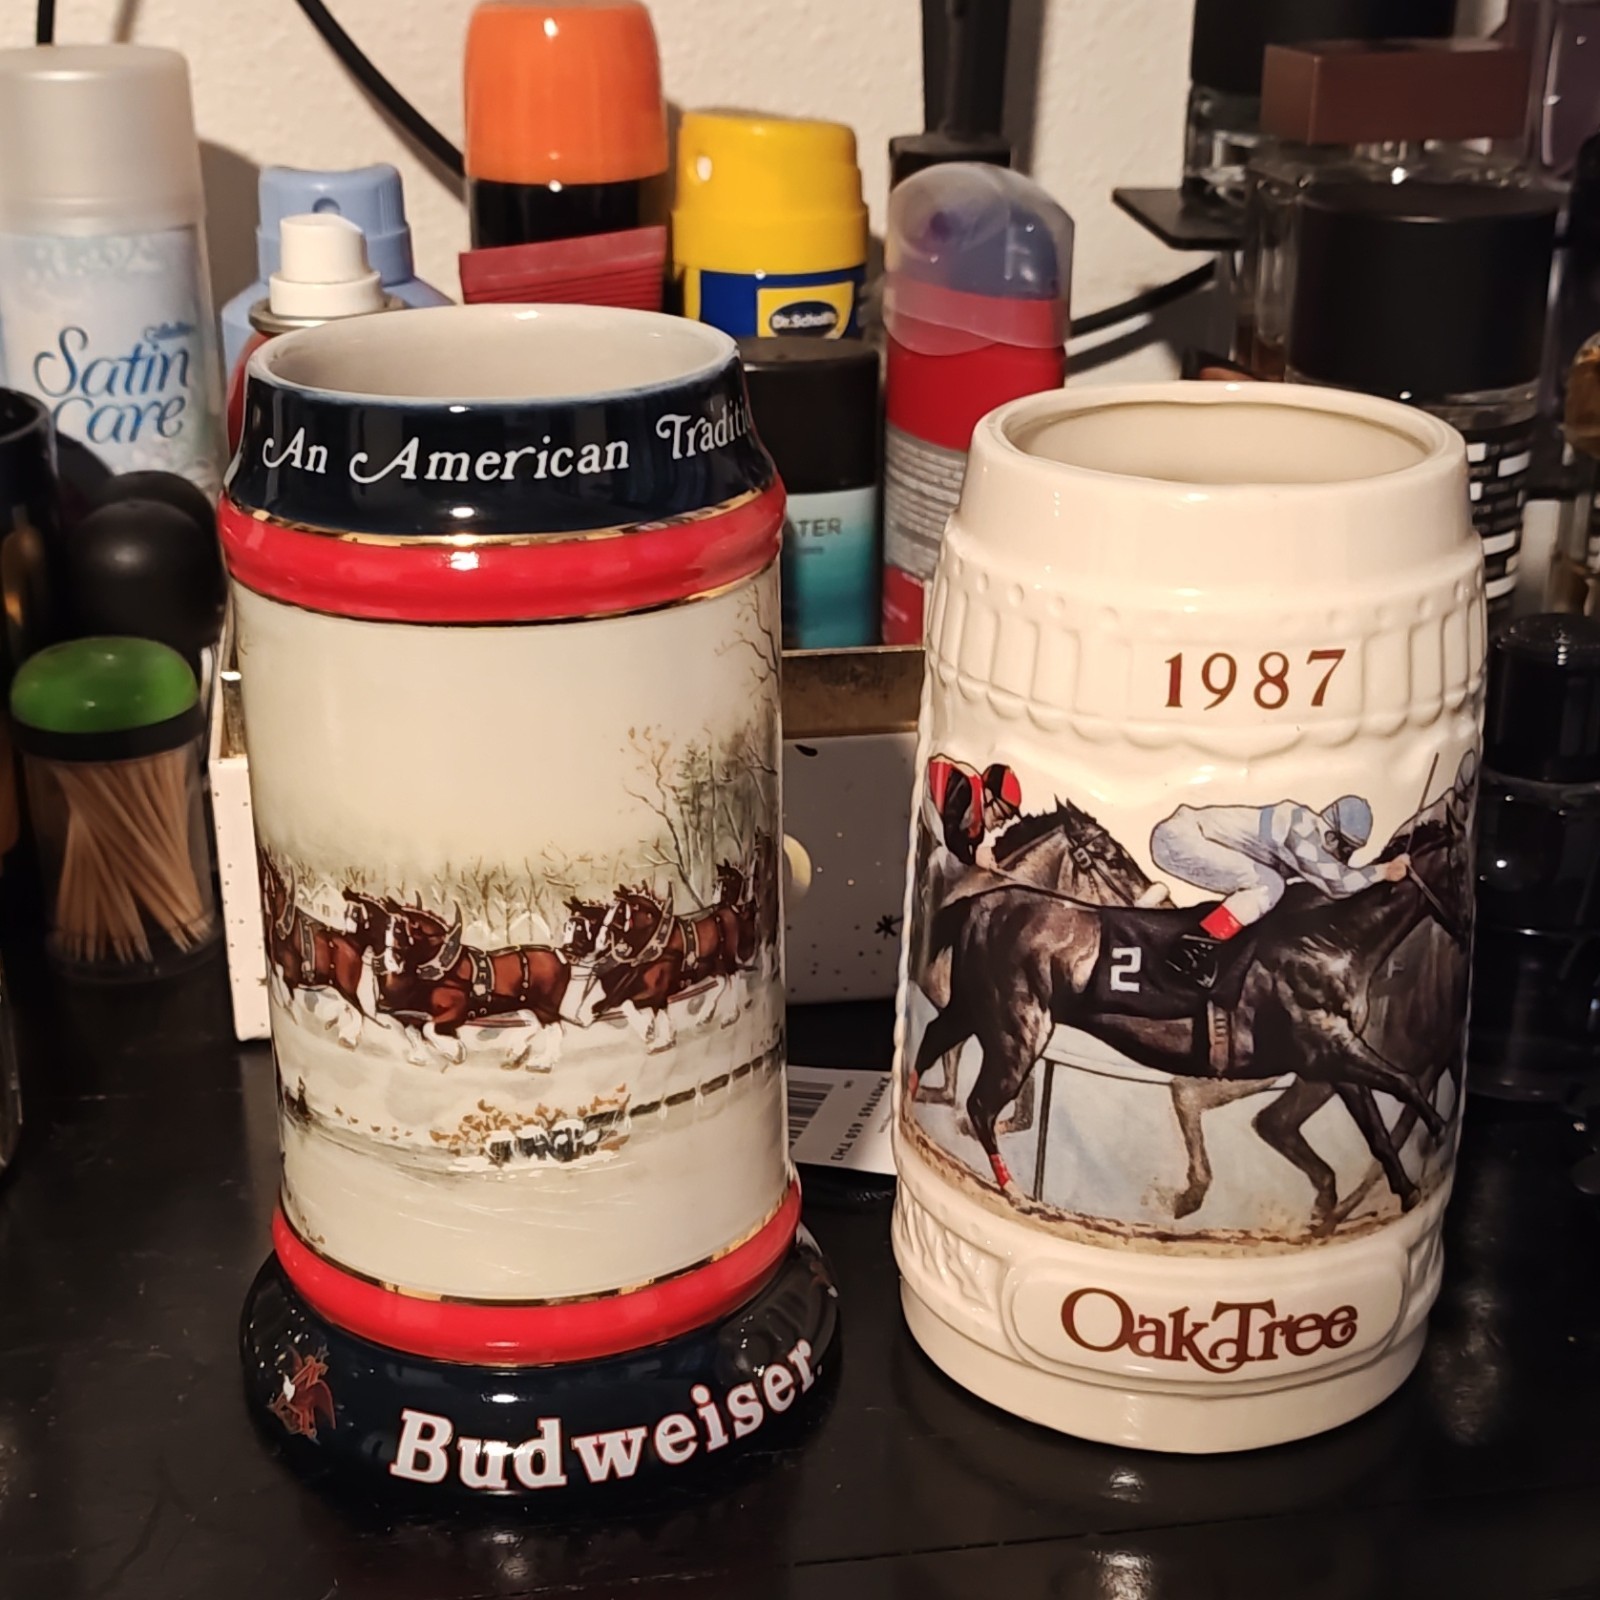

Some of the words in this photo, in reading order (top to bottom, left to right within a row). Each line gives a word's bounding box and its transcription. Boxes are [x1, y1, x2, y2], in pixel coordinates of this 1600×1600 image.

[33, 326, 189, 397] Satin
[262, 427, 328, 475] An
[349, 433, 630, 484] American
[797, 517, 842, 537] TER
[1164, 649, 1346, 710] 1987
[1110, 946, 1142, 993] 2
